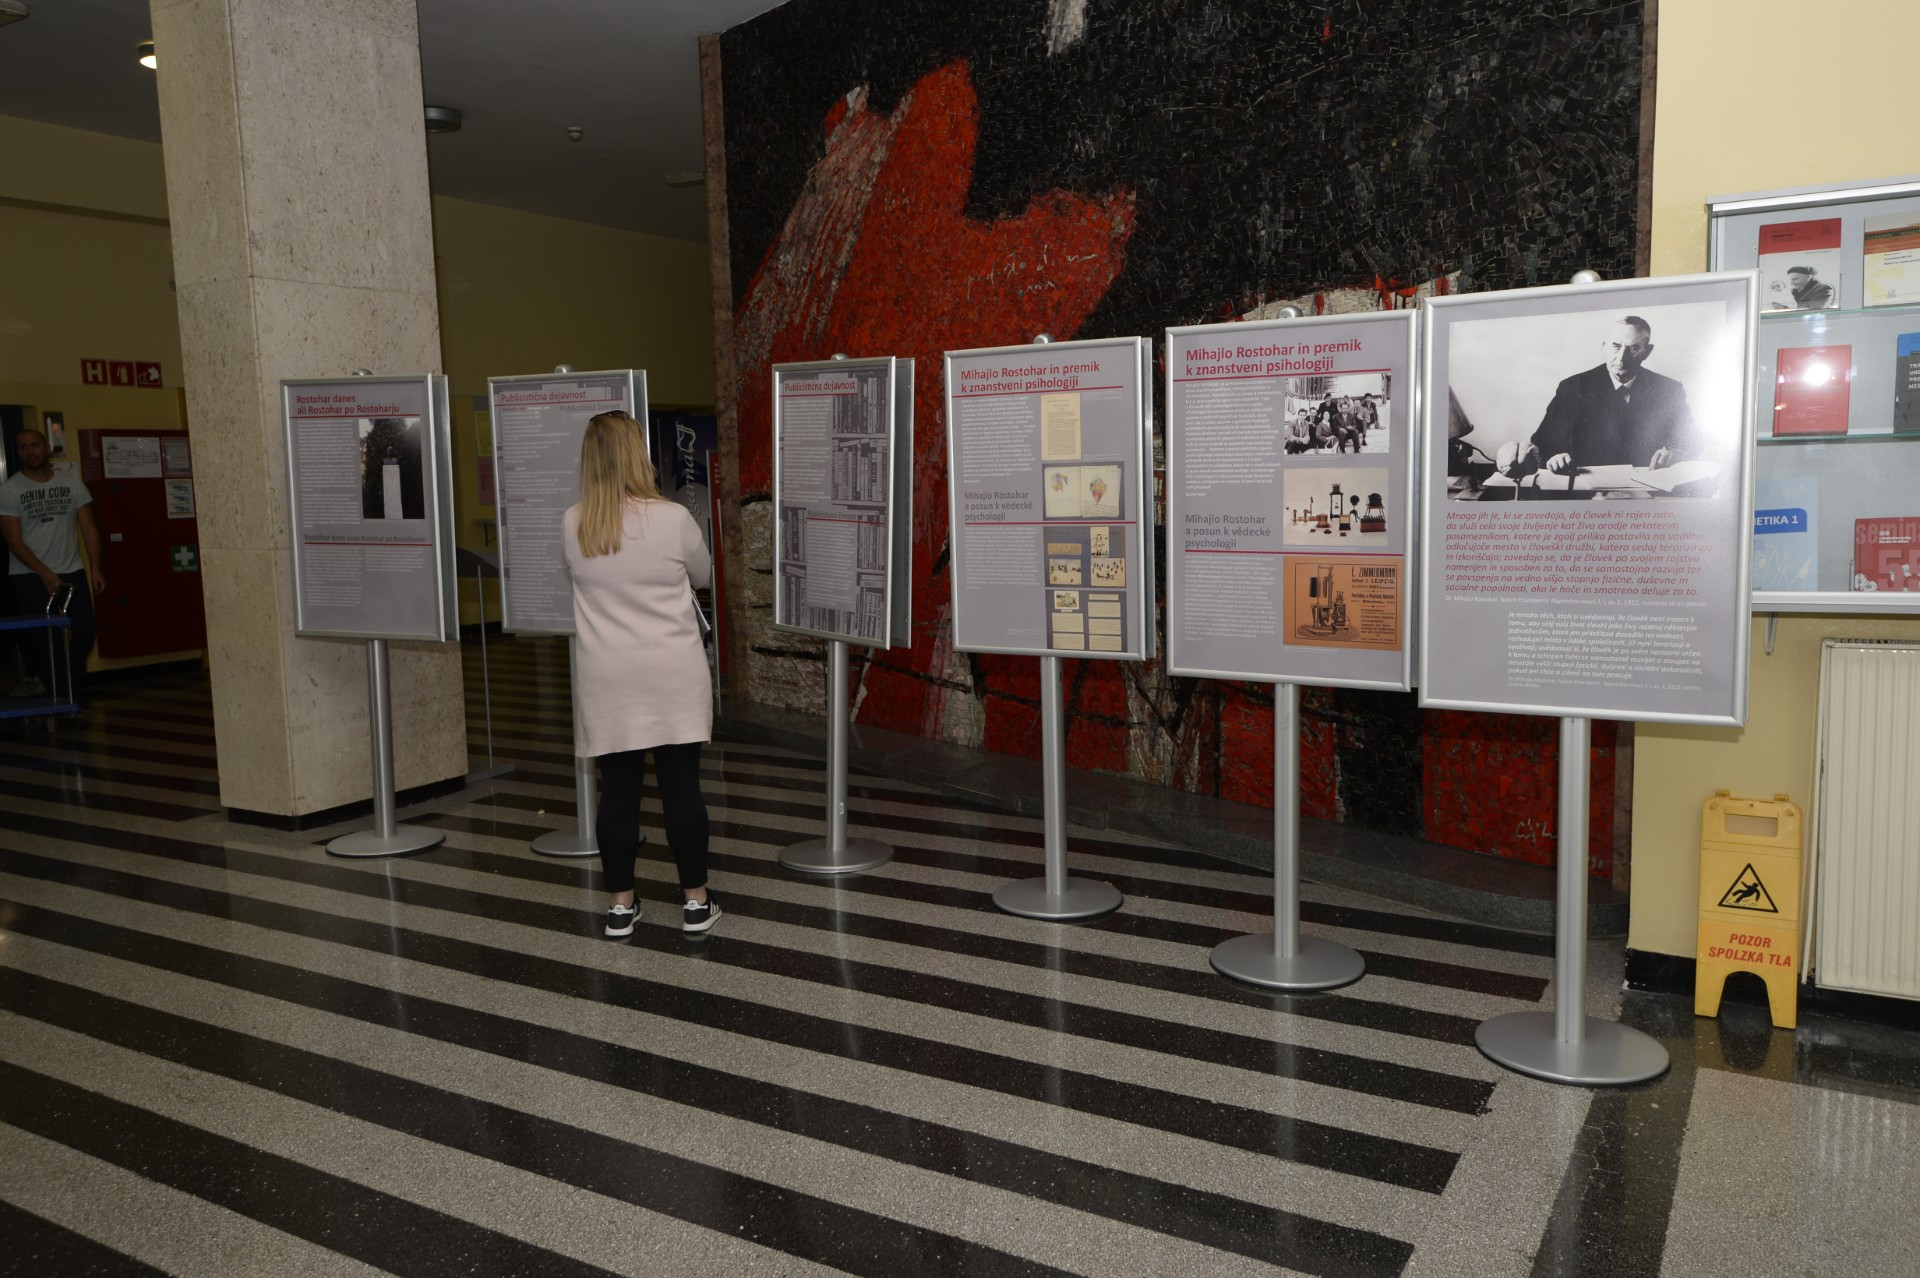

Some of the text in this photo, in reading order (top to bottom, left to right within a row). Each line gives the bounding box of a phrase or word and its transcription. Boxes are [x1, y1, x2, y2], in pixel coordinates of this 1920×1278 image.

[1186, 339, 1361, 362] Mihajlo Rostohar in premik
[961, 361, 1099, 381] Mihajlo Rostohar in premik
[1186, 357, 1334, 376] k znanstveni psihologiji
[87, 362, 103, 382] H
[785, 381, 855, 391] Publicistična dejavnost
[961, 376, 1078, 393] k znanstveni psihologiji
[333, 394, 356, 402] danes
[501, 391, 586, 402] Publicistična dejavnost
[298, 404, 399, 416] ali Rostohar po Rostoharju
[21, 488, 46, 504] DENIM
[965, 491, 1028, 501] Mihajlo Rostohar
[1002, 501, 1032, 509] vědecké
[965, 513, 1005, 521] psychologii
[1186, 515, 1266, 525] Mihajlo Rostohar
[1447, 512, 1476, 521] Mnogo
[1478, 512, 1488, 521] jih
[1490, 512, 1500, 521] je,
[1525, 512, 1566, 521] zavedajo,
[1570, 511, 1581, 519] da
[1584, 511, 1612, 519] človek
[1615, 511, 1623, 519] ni
[1626, 512, 1650, 521] rojen
[1754, 516, 1788, 525] ETIKA
[1194, 528, 1221, 536] posun
[1224, 527, 1229, 535] k
[1232, 527, 1271, 536] vědecké
[1459, 522, 1477, 530] služi
[1480, 522, 1496, 530] celo
[1499, 523, 1520, 531] svoje
[1523, 523, 1558, 531] življenje
[1598, 522, 1627, 531] orodje
[1856, 517, 1920, 544] semin
[1446, 533, 1511, 542] posameznikom,
[1543, 534, 1552, 542] je
[1554, 533, 1574, 542] zgolj
[1578, 532, 1605, 542] prilika
[1608, 532, 1650, 542] postavila
[1186, 539, 1236, 549] psychologii
[1446, 543, 1490, 552] odločujoče
[1529, 543, 1563, 551] človeški
[1566, 543, 1596, 552] družbi,
[1600, 543, 1629, 551] katero
[1632, 543, 1657, 553] sedaj
[1456, 553, 1501, 562] izkoriščajo;
[1504, 554, 1542, 563] zavedajo
[1573, 555, 1582, 564] je
[1585, 554, 1613, 562] človek
[1630, 555, 1663, 564] svojem
[1359, 567, 1395, 577] ZIMMERMANN
[1445, 564, 1486, 572] namenjen
[1500, 564, 1540, 573] sposoben
[1555, 565, 1566, 573] to,
[1595, 566, 1650, 574] samostojno
[1653, 566, 1684, 574] razvija
[1544, 575, 1563, 583] višjo
[1566, 576, 1600, 585] stopnjo
[1602, 575, 1634, 585] fizične,
[1637, 576, 1676, 584] duševne
[1445, 584, 1479, 592] socialne
[1481, 585, 1528, 593] popolnosti,
[1560, 586, 1581, 594] hoče
[1641, 587, 1670, 596] deluje
[1729, 933, 1771, 948] POZOR
[1709, 946, 1791, 967] SPOLZKA TLA
